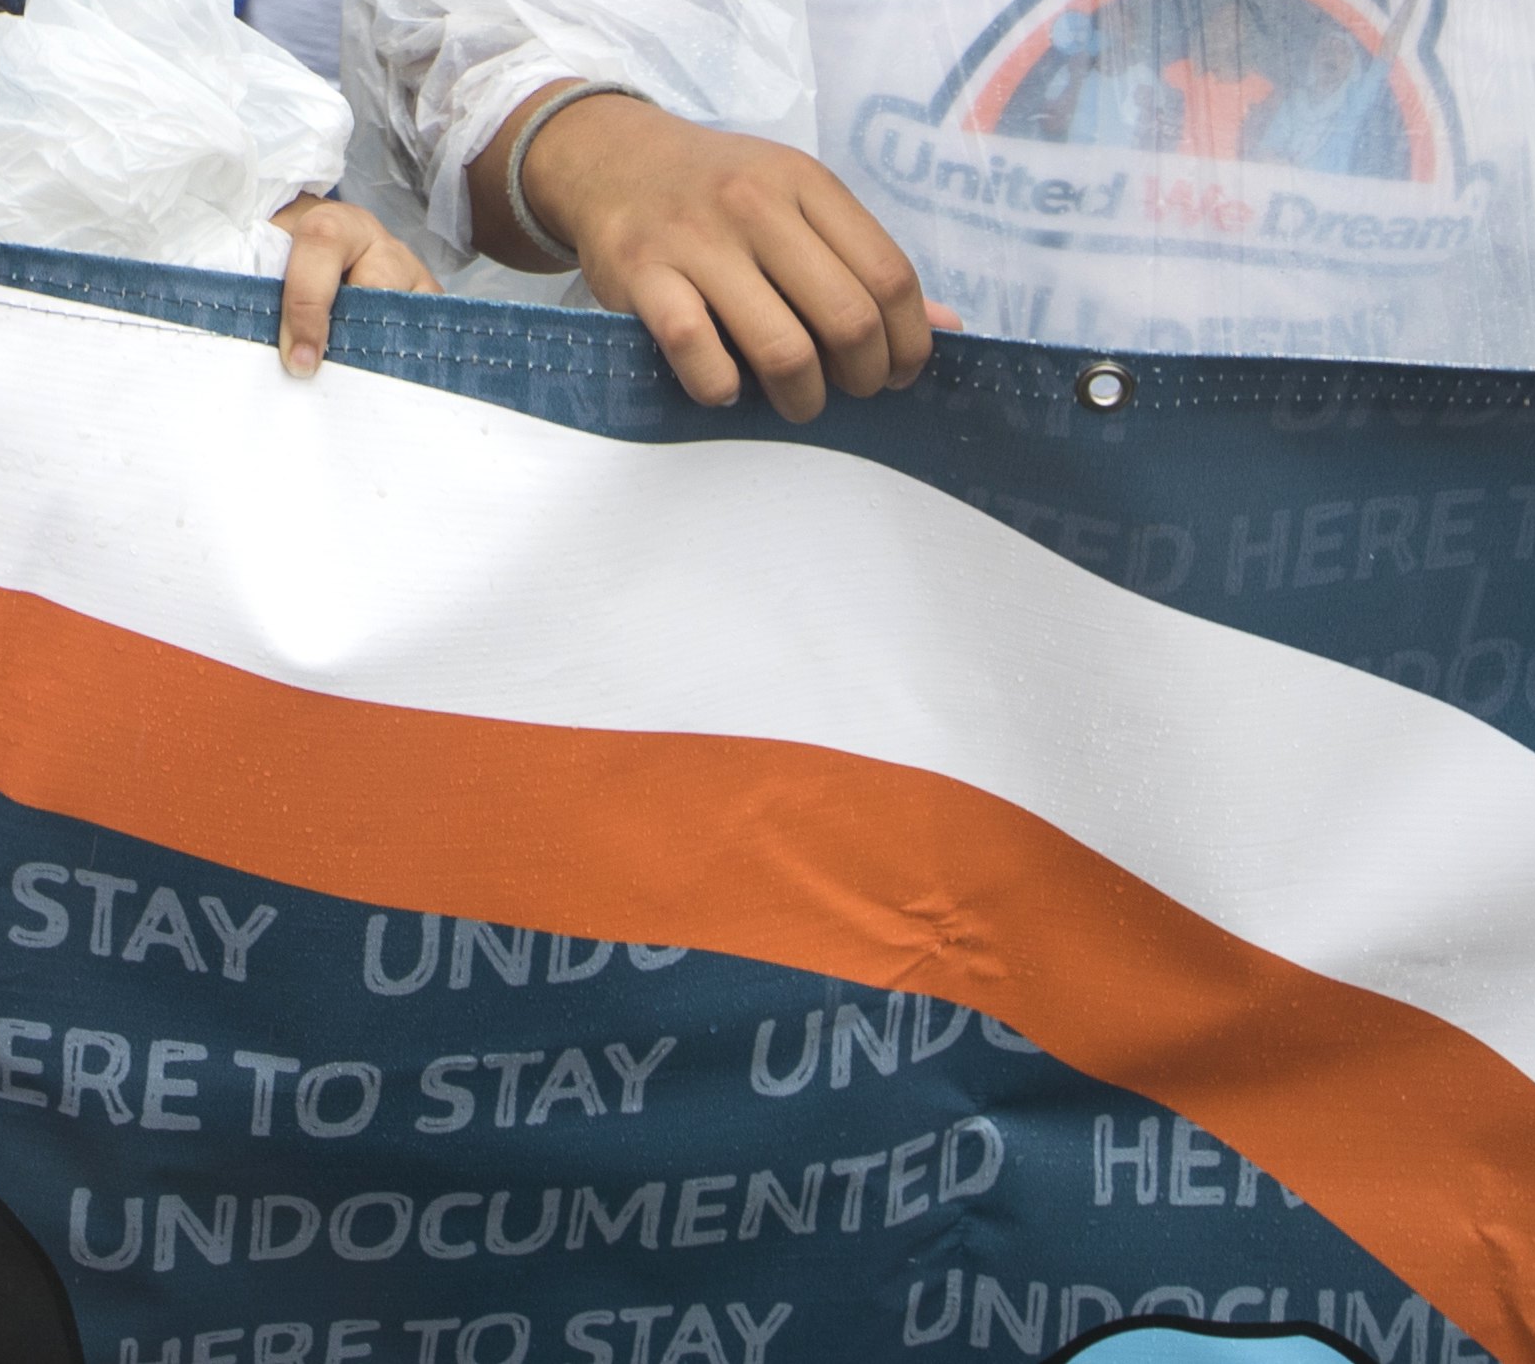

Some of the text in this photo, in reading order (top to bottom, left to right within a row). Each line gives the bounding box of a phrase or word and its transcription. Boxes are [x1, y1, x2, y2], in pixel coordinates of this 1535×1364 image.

[875, 128, 1475, 253] United We Dream
[1224, 488, 1488, 598] HERE
[8, 860, 277, 982] STAY
[233, 1048, 383, 1139] TO
[416, 1034, 679, 1134] STAY
[68, 1115, 1004, 1274] UNDOCUMENTED
